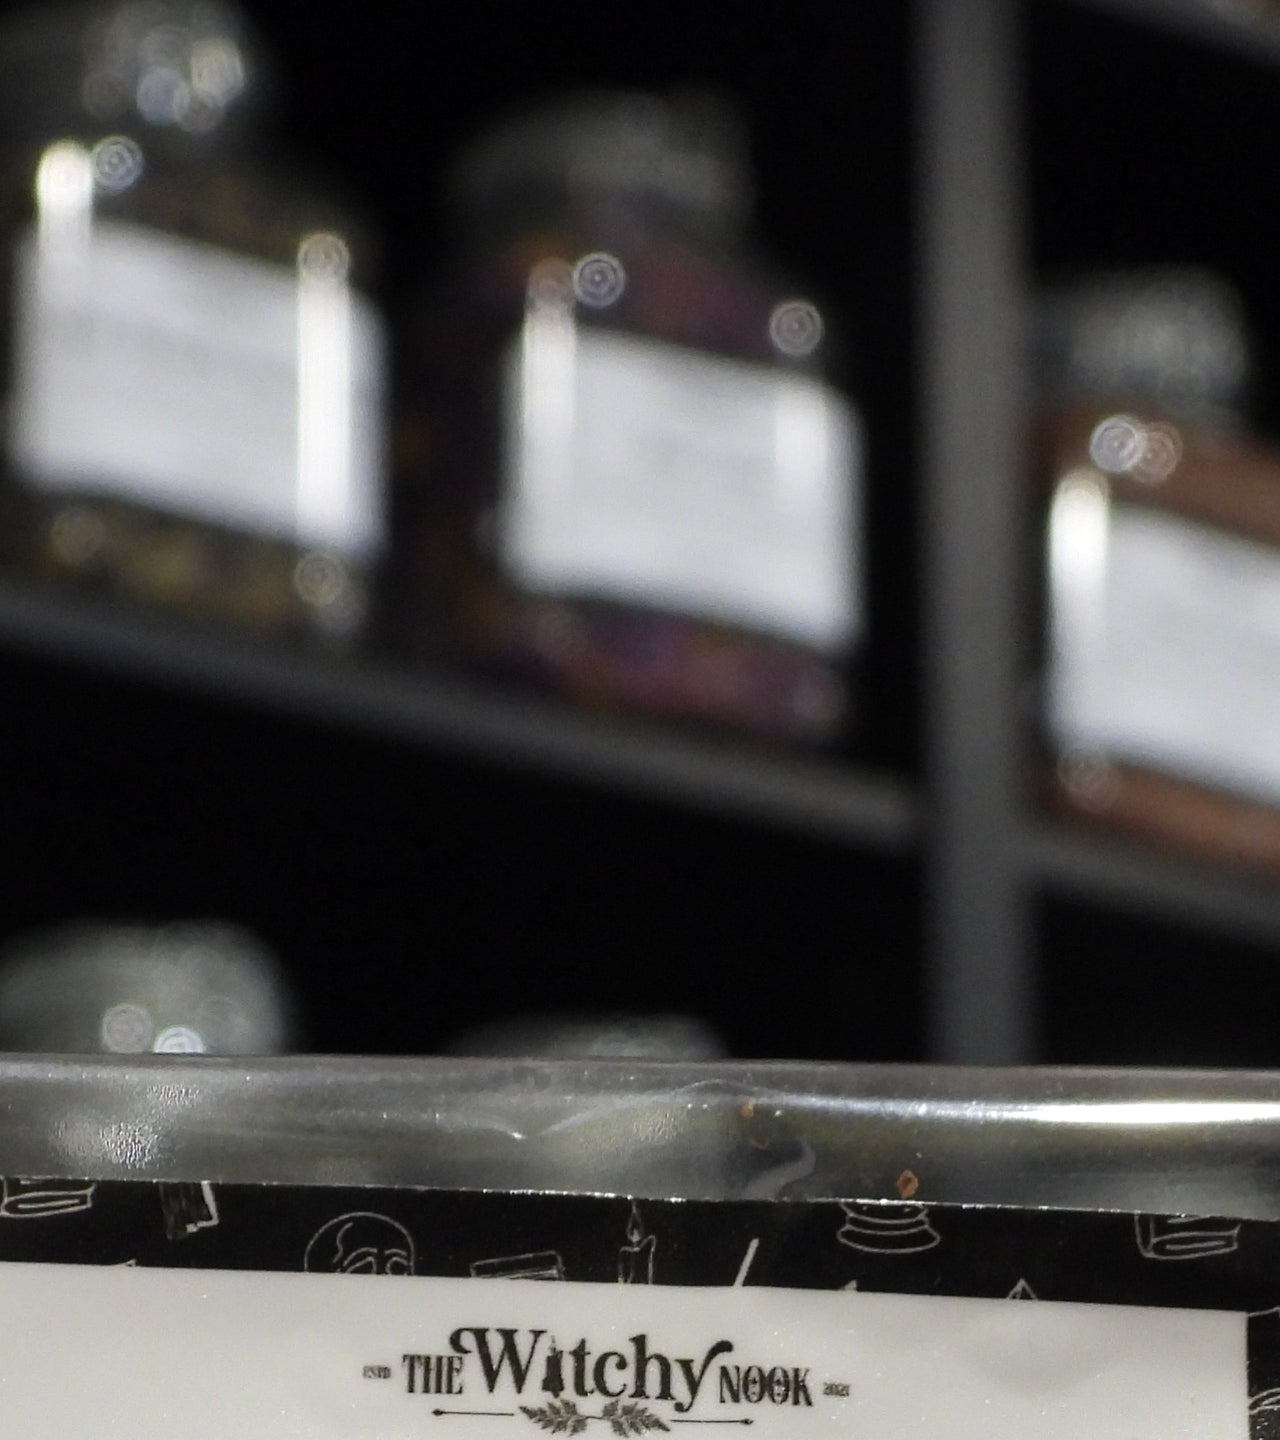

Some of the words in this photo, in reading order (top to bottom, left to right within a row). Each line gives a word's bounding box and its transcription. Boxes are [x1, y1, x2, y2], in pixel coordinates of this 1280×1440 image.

[402, 1354, 463, 1395] THE
[449, 1327, 734, 1412] Witchy
[719, 1365, 814, 1407] NOOK
